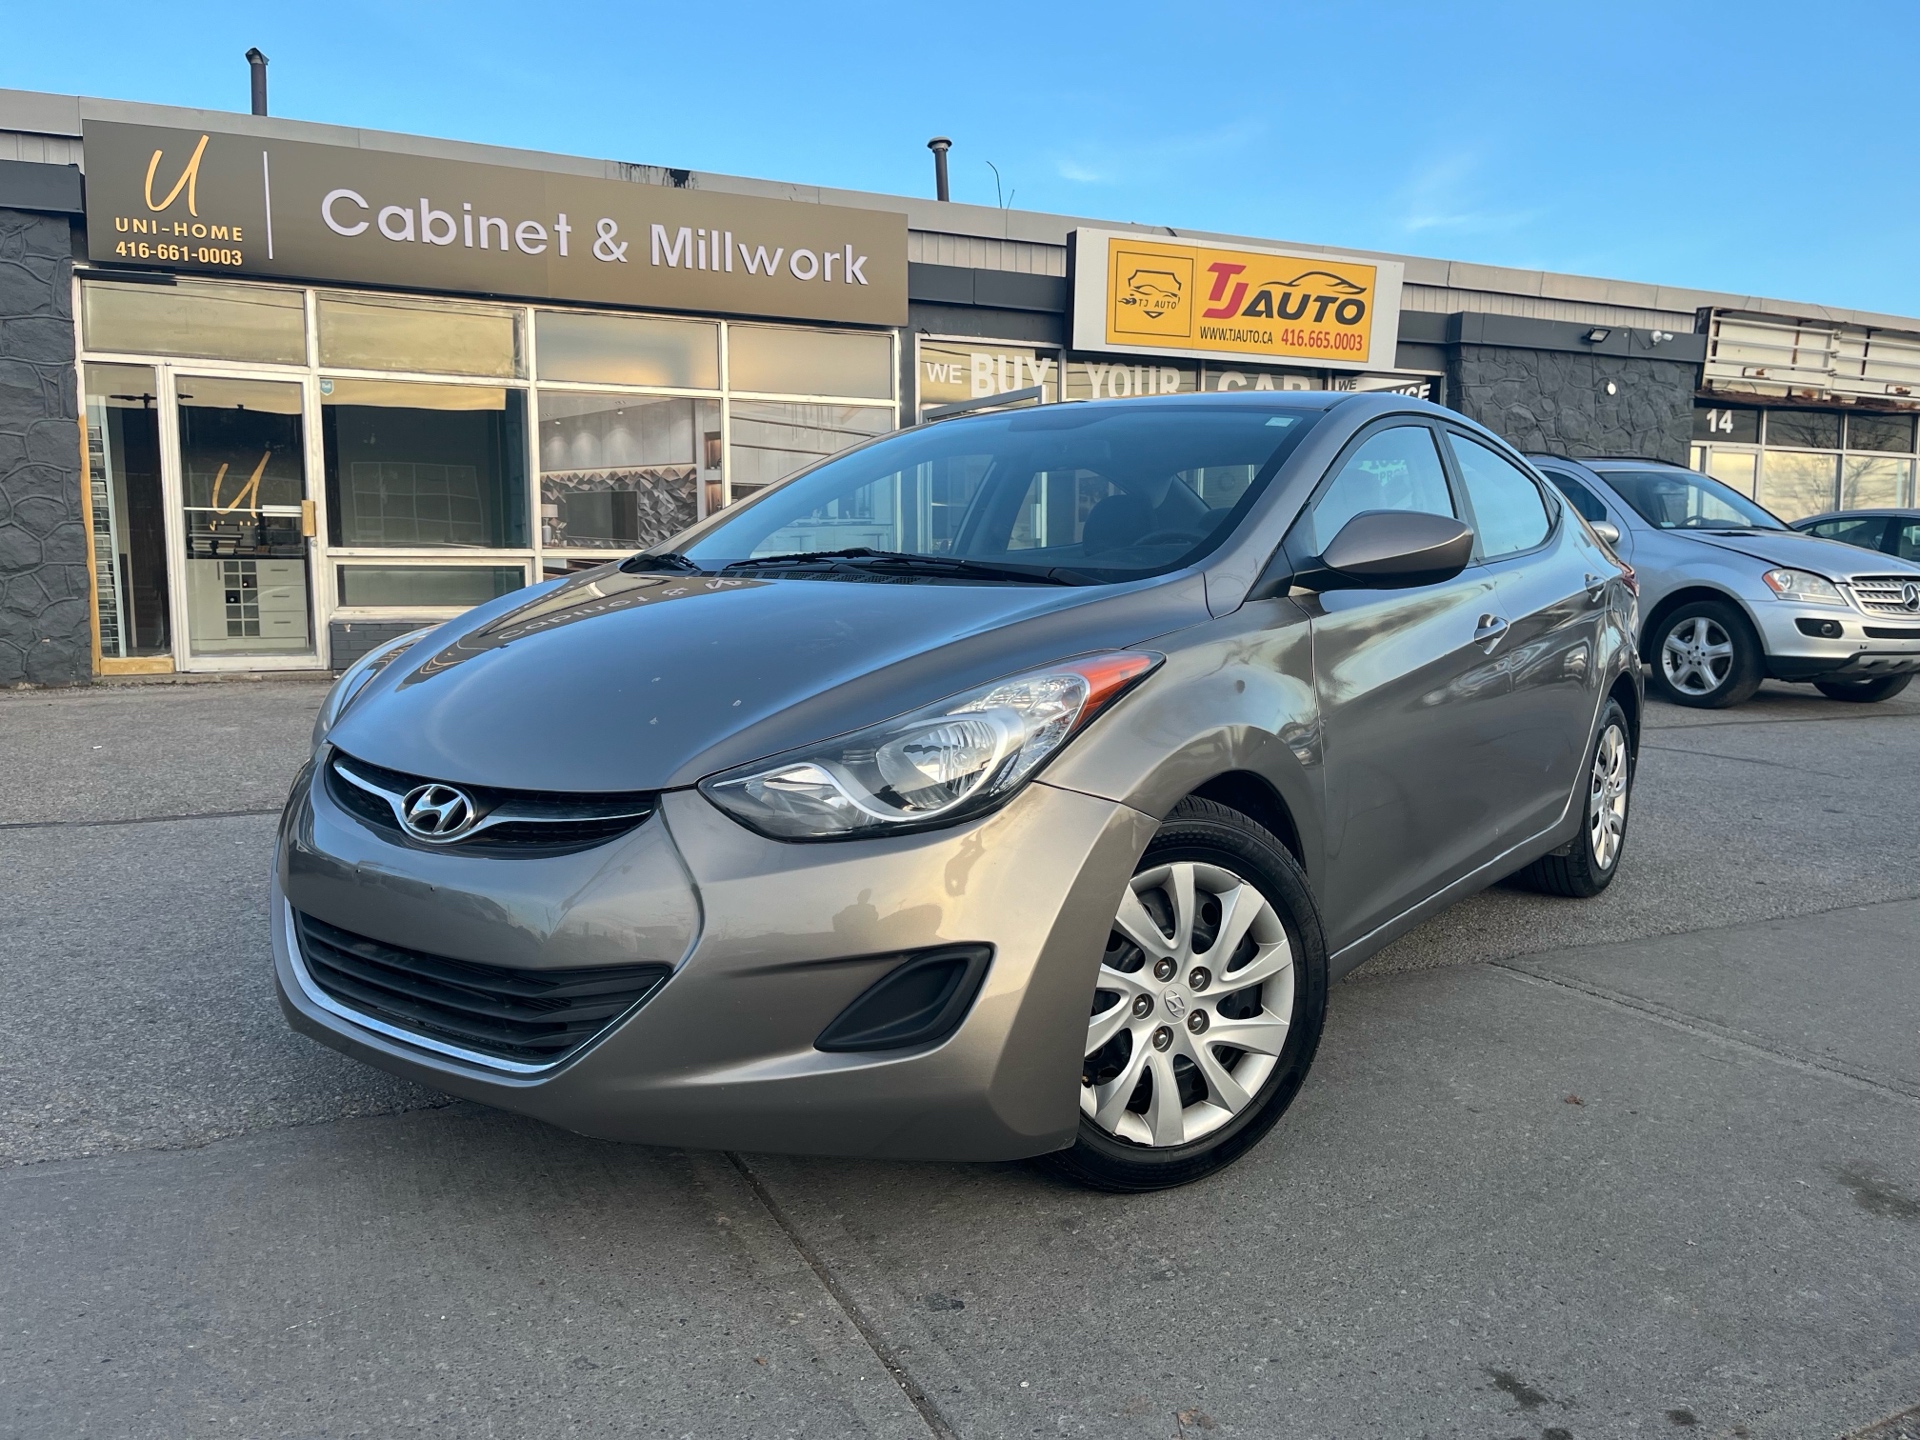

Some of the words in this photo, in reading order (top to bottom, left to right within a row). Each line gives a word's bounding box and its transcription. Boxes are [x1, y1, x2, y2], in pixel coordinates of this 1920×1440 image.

[114, 216, 244, 243] UNI-HOME
[320, 188, 573, 257] Cabinet
[591, 217, 629, 264] &
[649, 223, 870, 286] Millwork
[114, 240, 244, 267] 416-661-0003
[1153, 300, 1177, 310] AUTO
[1240, 289, 1367, 326] AUTO
[1199, 325, 1274, 346] WWW.TJAUTO.CA
[1280, 328, 1364, 352] 416.665.0003
[926, 362, 963, 385] WE
[970, 352, 1052, 399] BUY
[1084, 361, 1181, 399] YOUR
[1338, 379, 1358, 391] WE
[1705, 408, 1733, 434] 14
